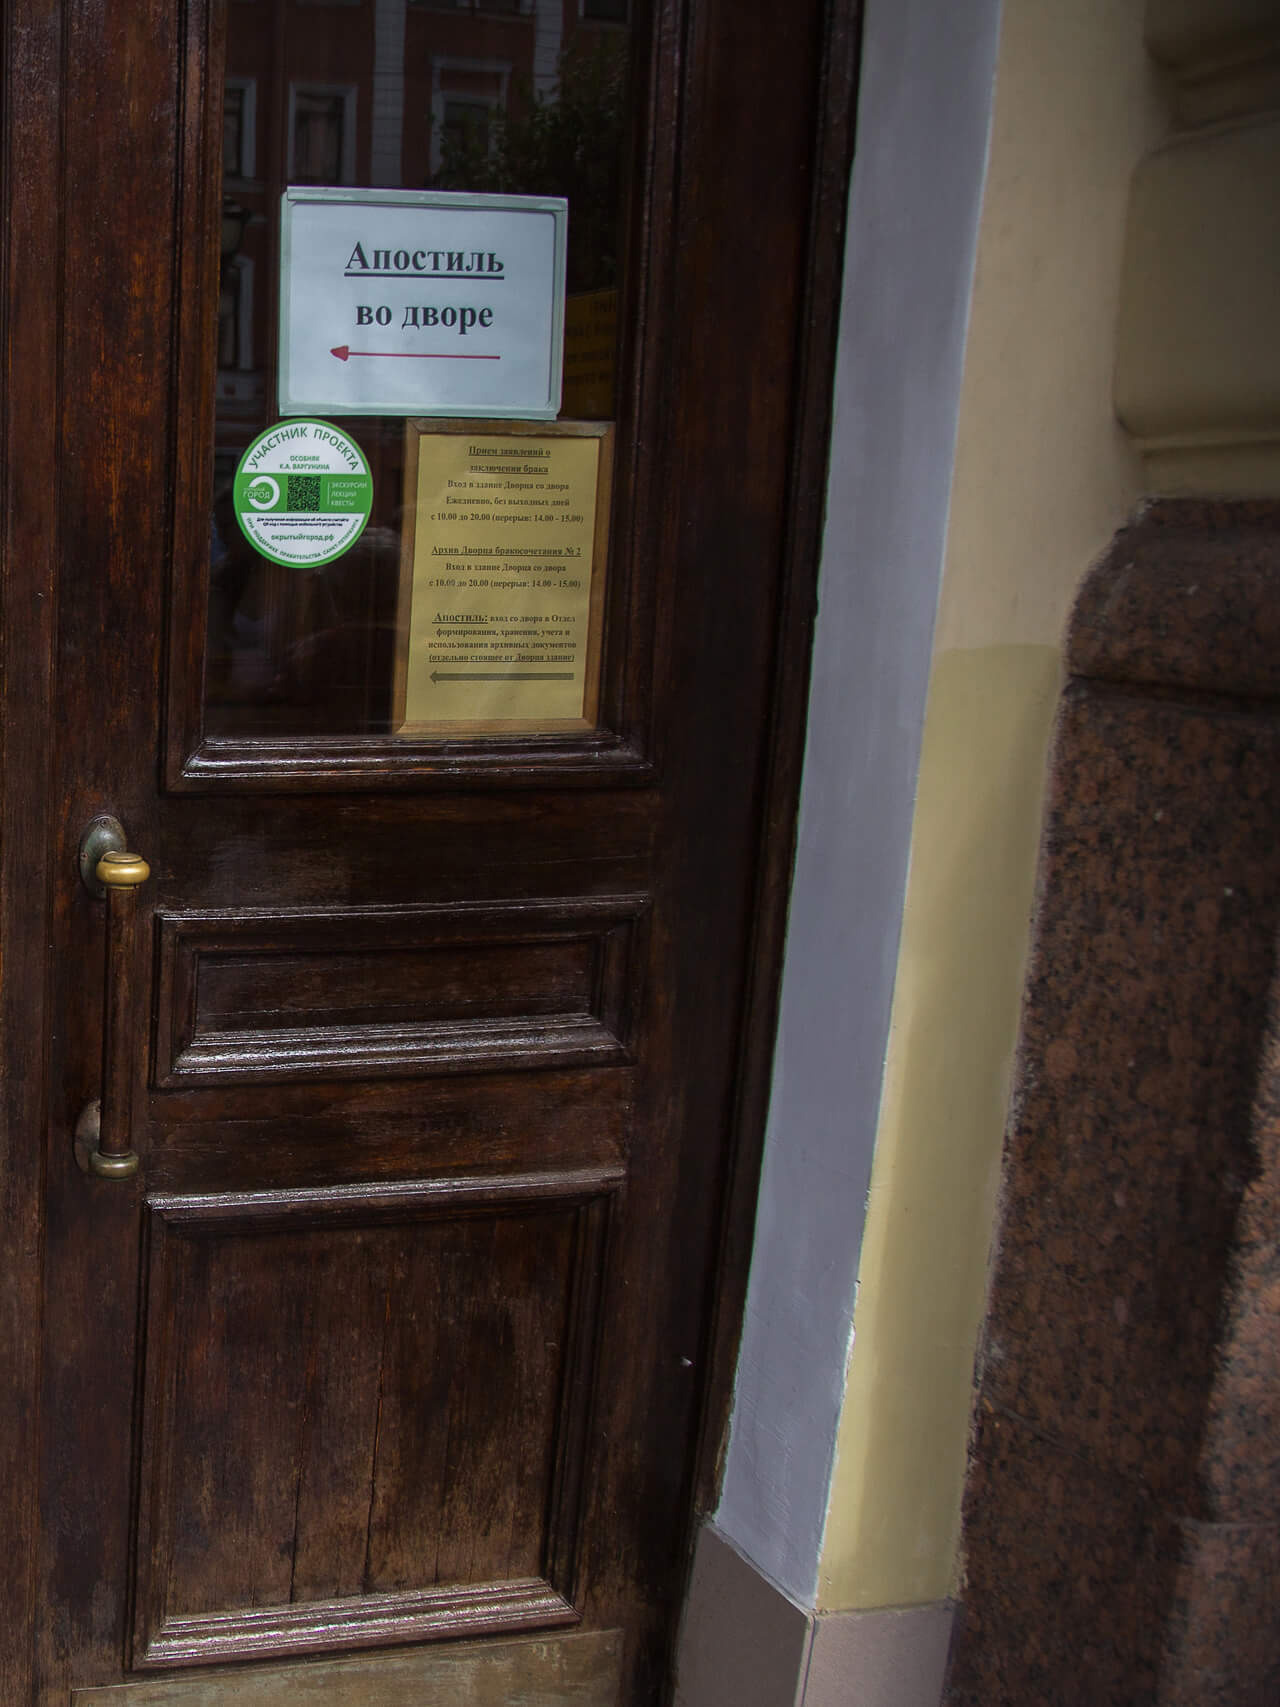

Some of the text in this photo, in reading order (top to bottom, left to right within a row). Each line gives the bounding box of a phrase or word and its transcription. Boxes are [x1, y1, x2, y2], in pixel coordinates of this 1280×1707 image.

[345, 241, 504, 273] Апостиль
[356, 305, 494, 335] во дворе
[248, 427, 359, 470] УЧАСТНИК ПРОЕКТА
[448, 480, 467, 488] Вход
[243, 490, 270, 499] ГОРОД
[437, 513, 457, 521] 10.00
[470, 513, 490, 521] 20.00
[534, 514, 554, 522] 14.00
[431, 546, 460, 556] Архив
[446, 563, 465, 571] Вход
[435, 579, 455, 587] 10.00
[469, 579, 489, 587] 20.00
[532, 580, 552, 588] 14.00
[434, 613, 488, 623] Апостиль:
